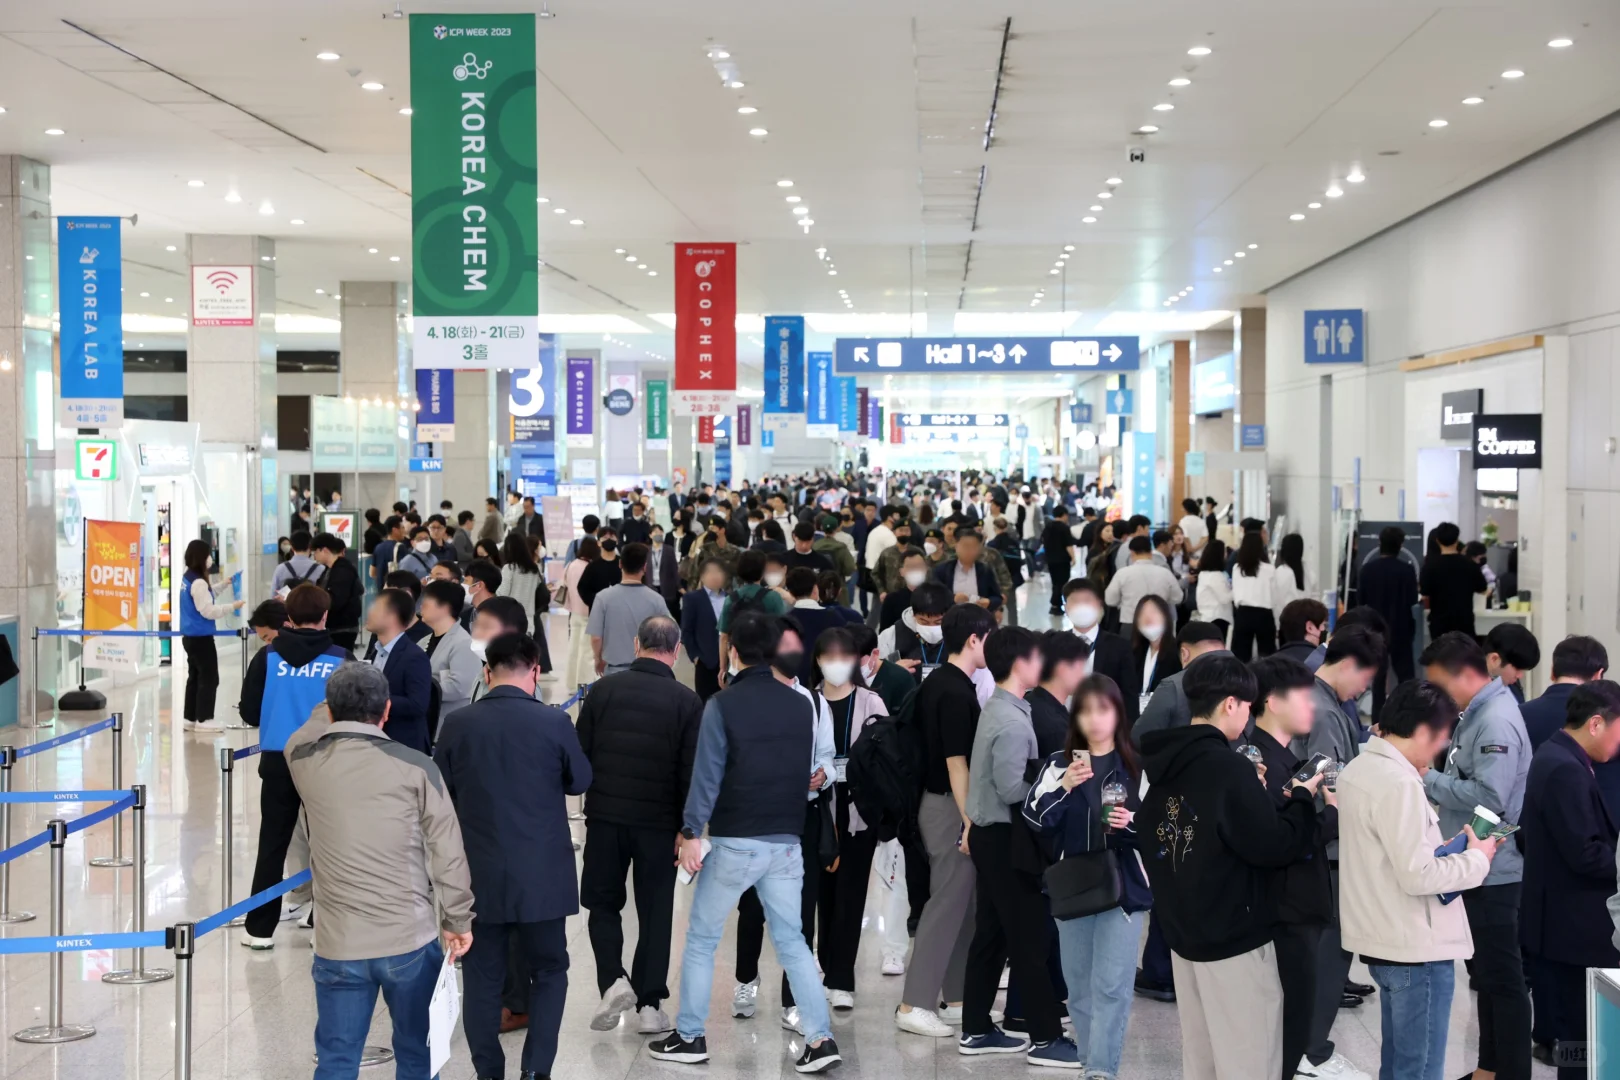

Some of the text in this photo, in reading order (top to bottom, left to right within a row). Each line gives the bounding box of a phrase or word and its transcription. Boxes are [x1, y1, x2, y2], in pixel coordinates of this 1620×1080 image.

[449, 28, 511, 36] ICPI WEEK 2023
[461, 92, 487, 291] KOREA CHEM
[83, 270, 99, 380] KOREA LAB
[489, 325, 525, 340] 21(금)
[699, 281, 712, 380] COPHEX
[462, 344, 489, 361] 3홀
[926, 344, 962, 364] Hall
[509, 360, 544, 417] 3
[1478, 440, 1536, 455] COFFEE
[422, 460, 442, 470] KIN
[90, 564, 136, 587] OPEN
[56, 938, 92, 948] KINTEX
